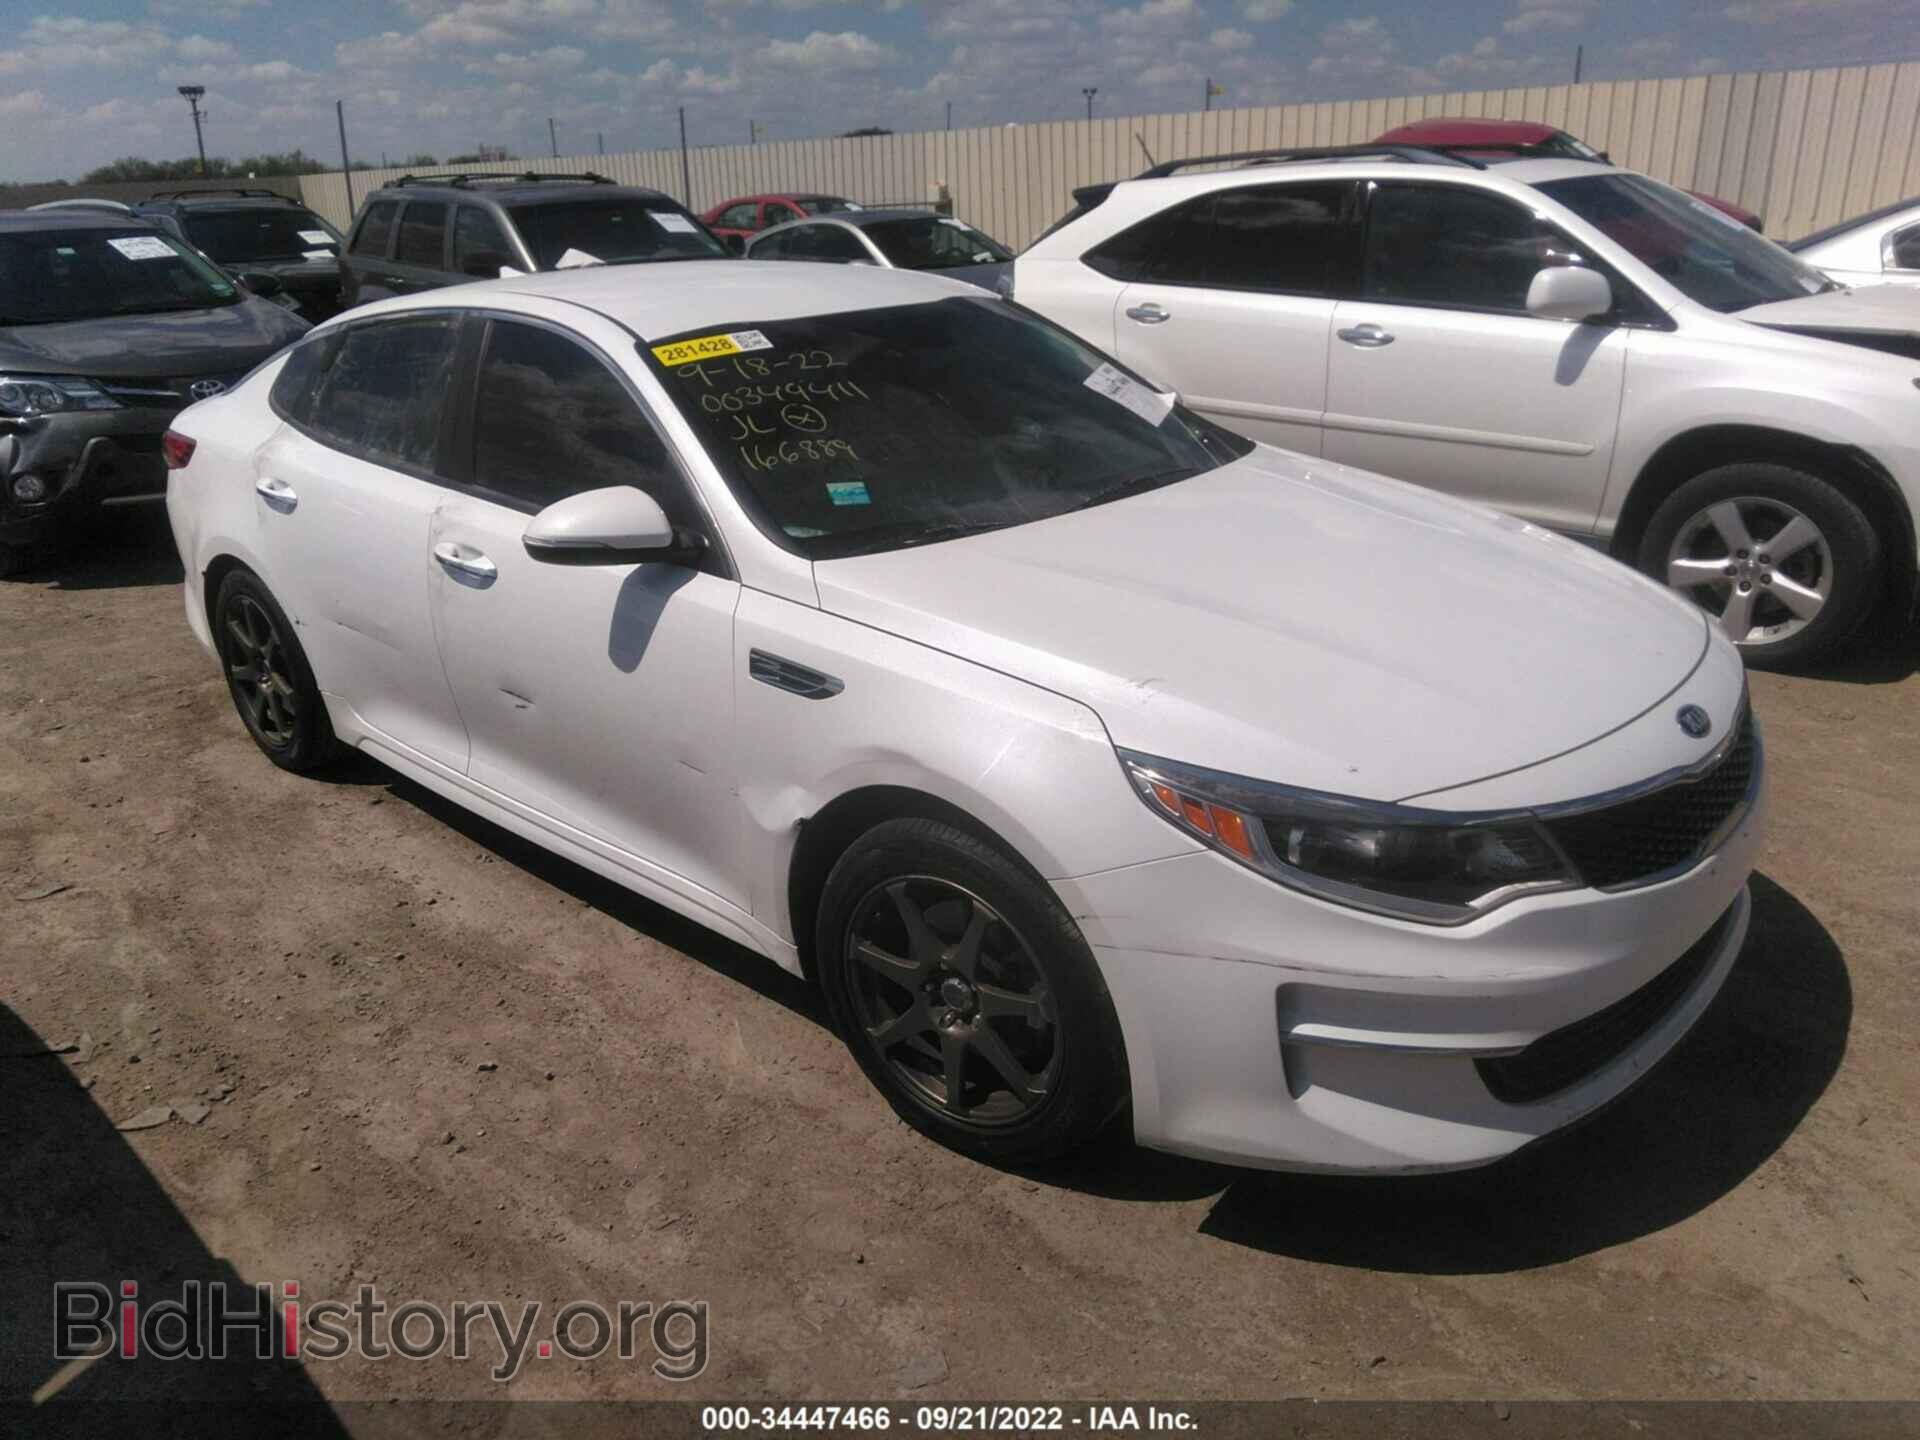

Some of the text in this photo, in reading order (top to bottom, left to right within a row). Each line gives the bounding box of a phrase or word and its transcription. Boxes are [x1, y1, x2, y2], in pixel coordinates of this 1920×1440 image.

[661, 338, 733, 361] 281428
[676, 351, 848, 387] 9-18-22
[740, 439, 859, 471] 166889
